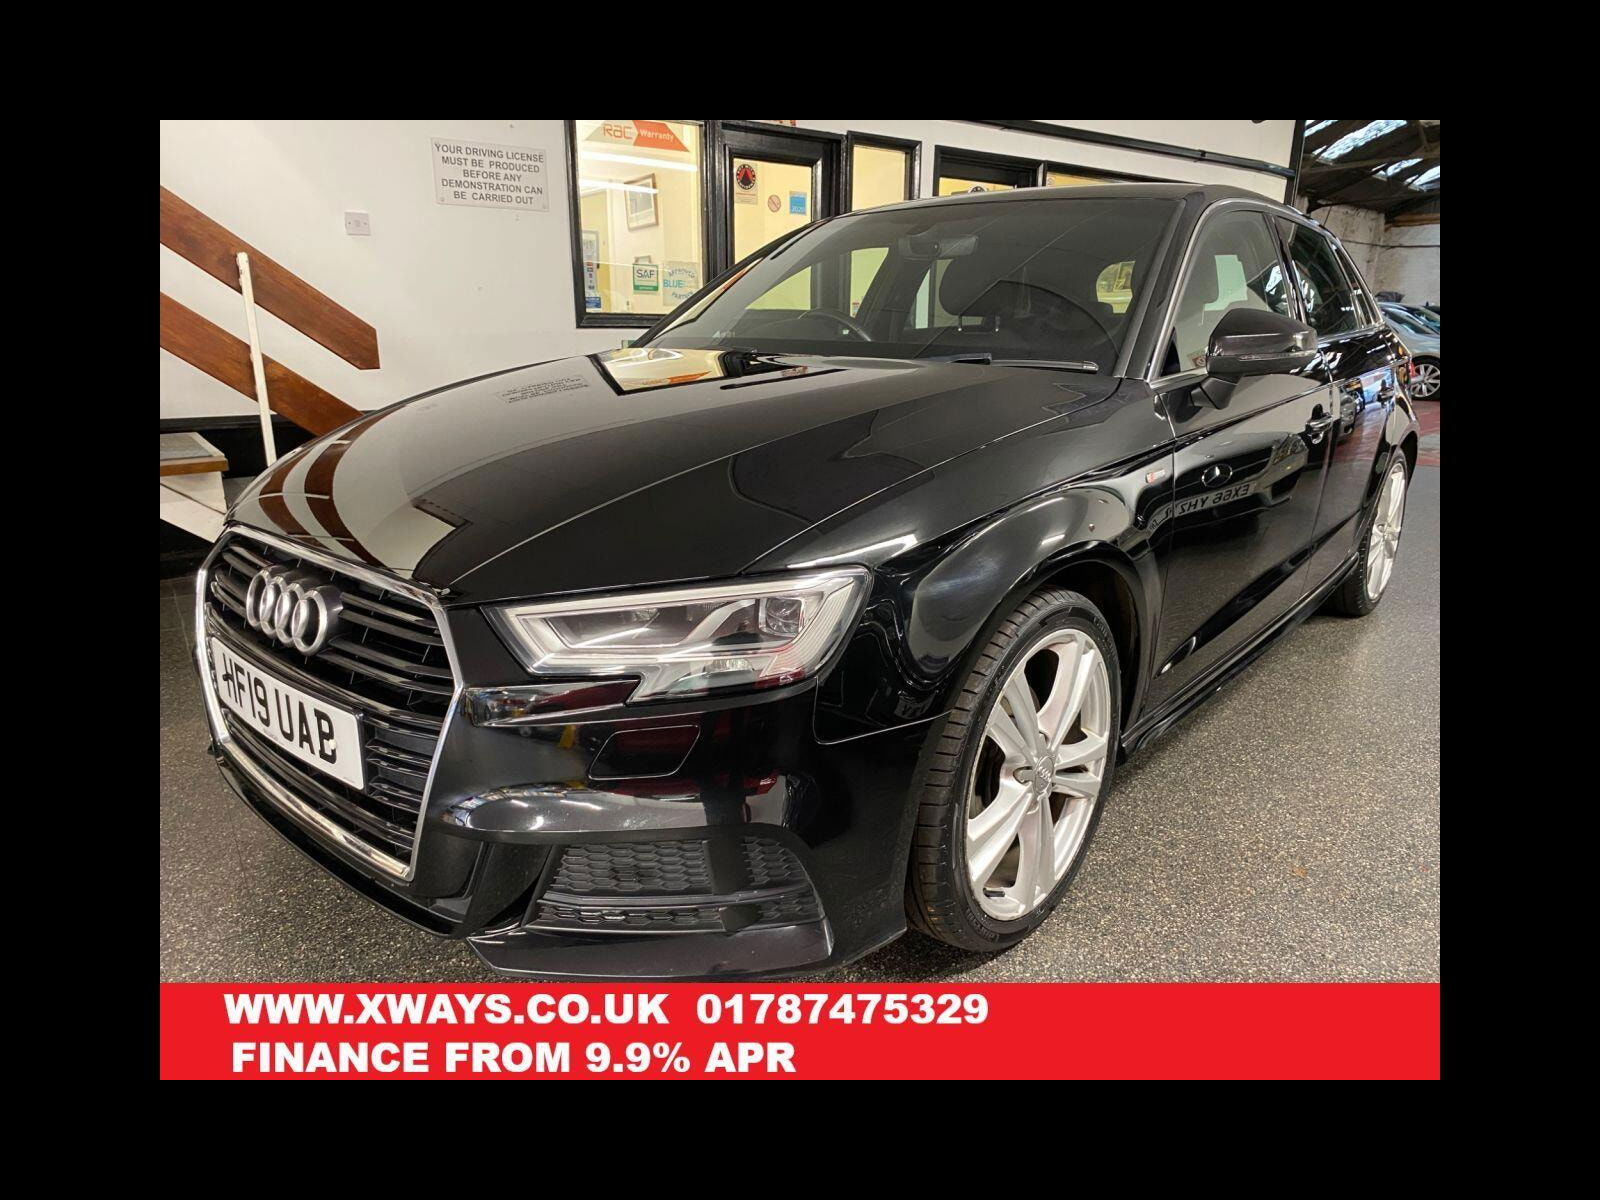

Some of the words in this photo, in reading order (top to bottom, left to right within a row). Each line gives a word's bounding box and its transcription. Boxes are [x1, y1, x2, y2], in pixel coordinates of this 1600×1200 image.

[640, 128, 675, 142] Warranty
[434, 143, 463, 154] YOUR
[465, 146, 504, 159] DRIVING
[506, 151, 545, 163] LICENSE
[441, 156, 468, 166] MUST
[471, 158, 485, 168] BE
[489, 160, 540, 173] PRODUCED
[463, 169, 502, 181] BEFORE
[503, 173, 522, 182] ANY
[441, 178, 522, 193] DEMONSTRATION
[524, 185, 543, 195] CAN
[453, 191, 468, 200] BE
[471, 192, 513, 203] CARRIED
[515, 196, 534, 205] OUT
[636, 268, 655, 279] SAF
[222, 652, 271, 728] HF19
[274, 688, 338, 765] UAB
